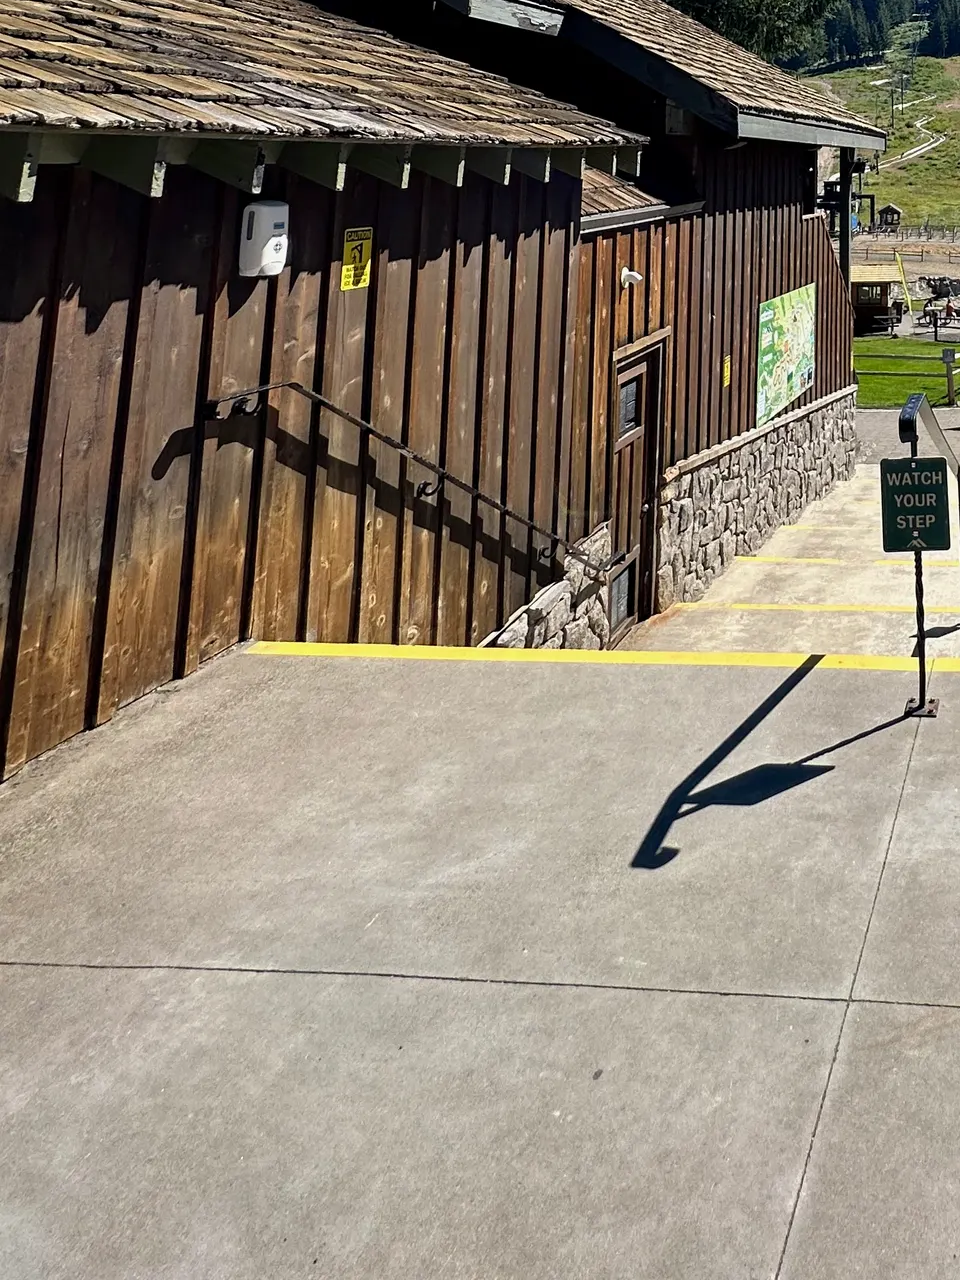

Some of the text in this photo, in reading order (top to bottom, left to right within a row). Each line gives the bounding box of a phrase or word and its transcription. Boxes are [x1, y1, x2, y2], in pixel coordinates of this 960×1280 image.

[347, 230, 371, 241] CAUTION
[887, 472, 942, 486] WATCH
[894, 493, 937, 507] YOUR
[897, 515, 936, 529] STEP
